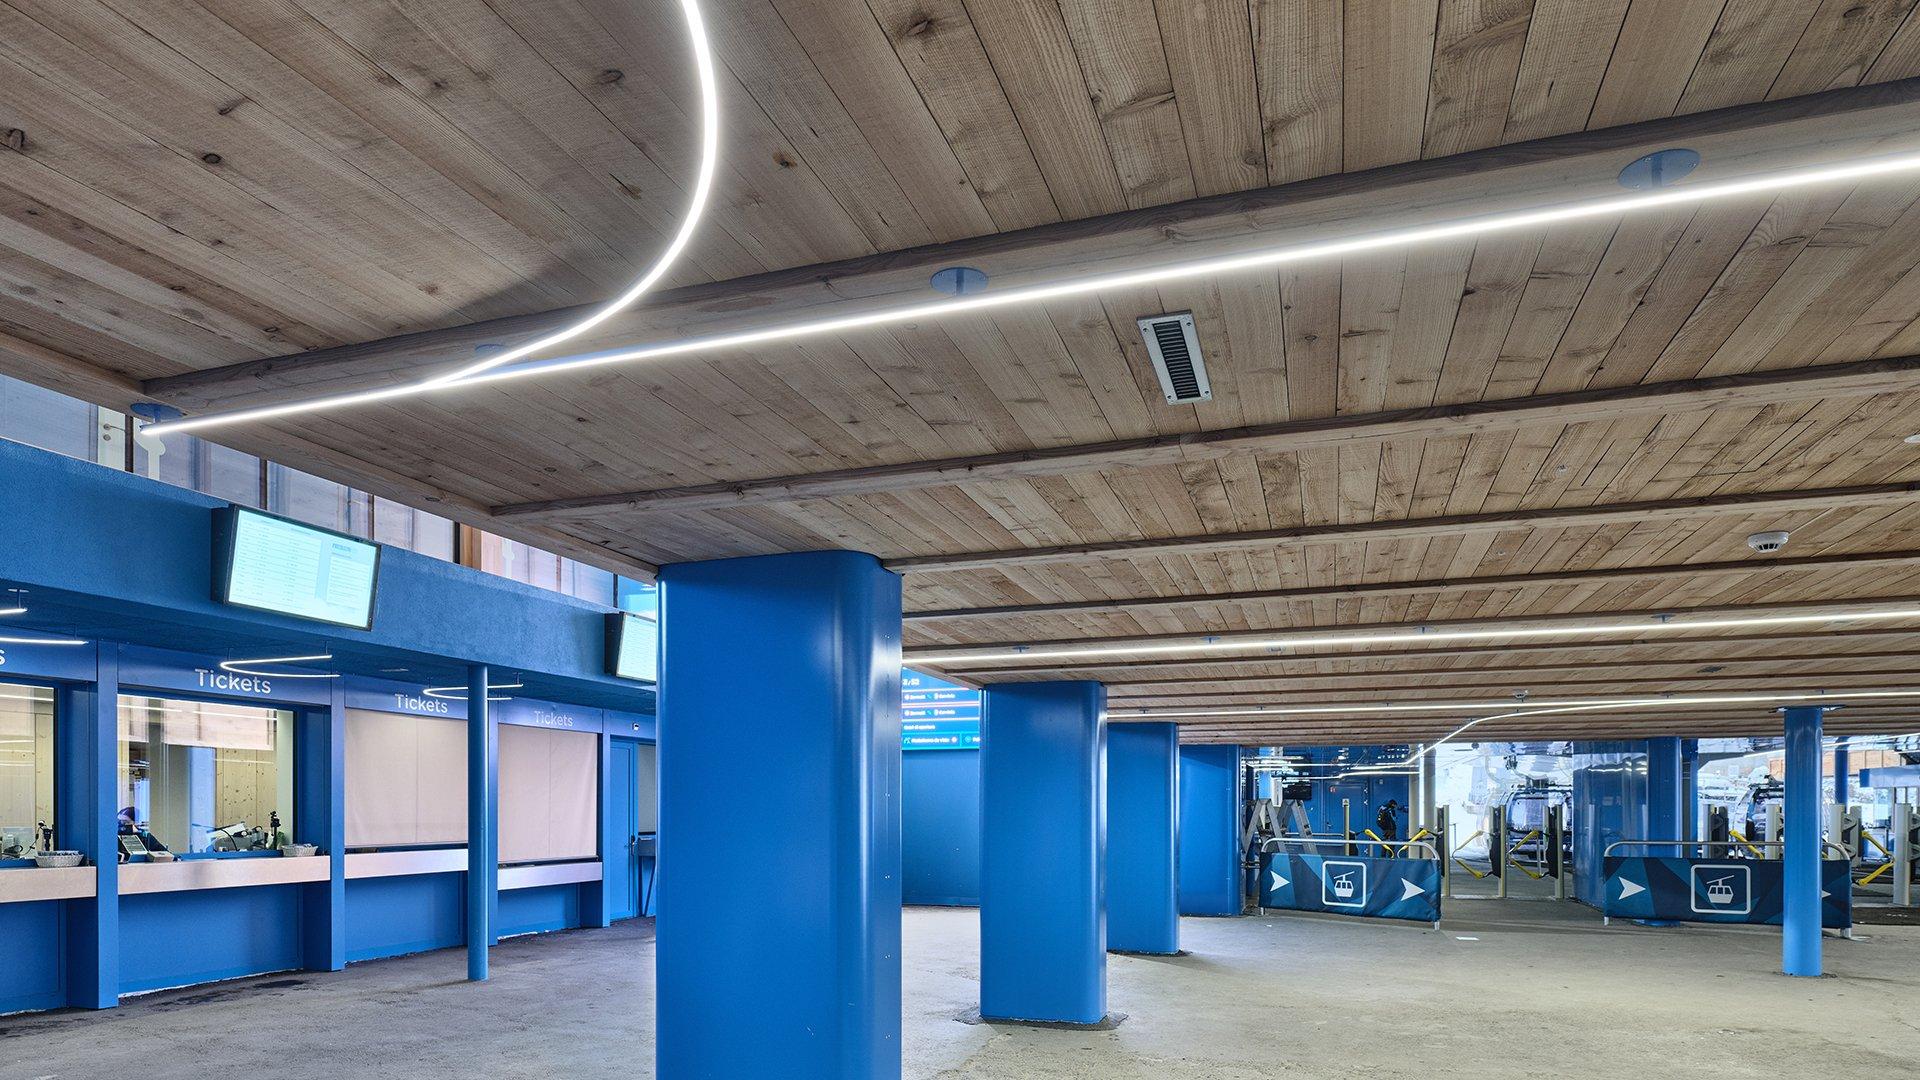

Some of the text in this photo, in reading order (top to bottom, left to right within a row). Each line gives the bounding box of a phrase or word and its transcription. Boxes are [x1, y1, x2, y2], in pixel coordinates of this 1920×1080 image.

[194, 668, 272, 694] Tickets
[394, 693, 448, 713] Tickets
[534, 710, 573, 727] Tickets
